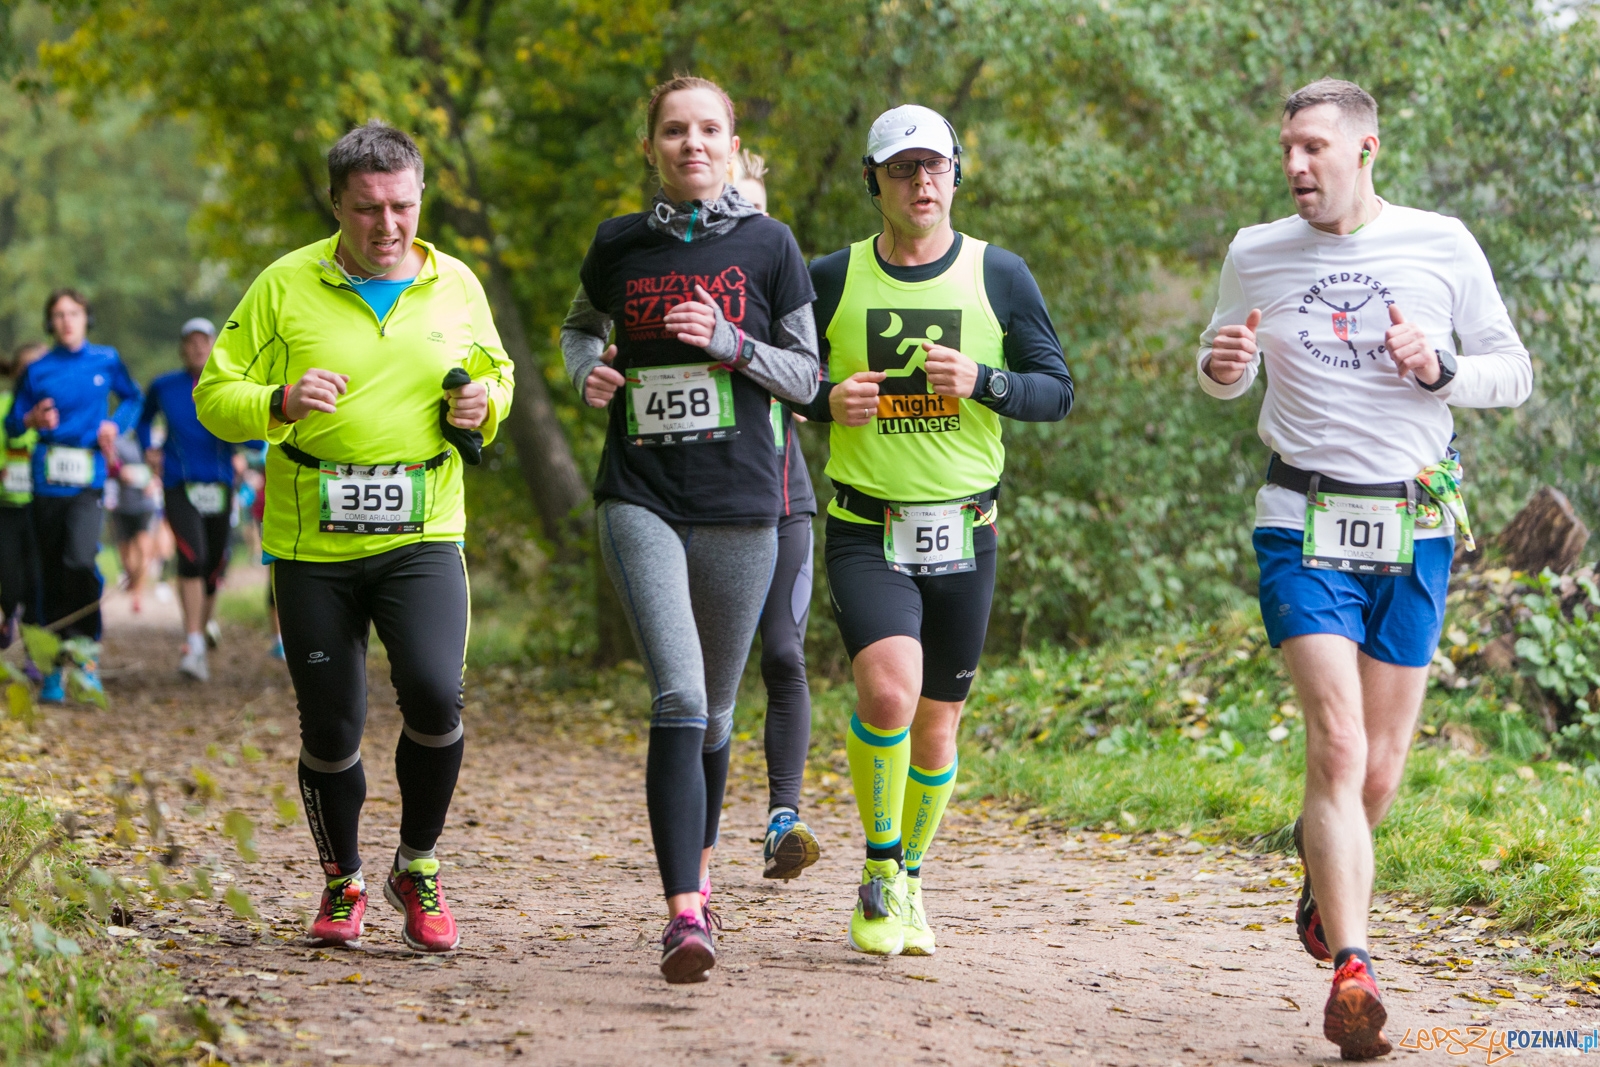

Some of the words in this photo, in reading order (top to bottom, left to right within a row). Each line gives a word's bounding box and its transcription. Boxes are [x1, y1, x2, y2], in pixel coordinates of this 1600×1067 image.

[626, 270, 725, 297] DRUŻYNA
[1298, 330, 1361, 370] Running
[645, 387, 711, 421] 458
[892, 395, 945, 416] night
[662, 422, 696, 431] NATALIA
[878, 416, 960, 434] runners
[341, 484, 404, 512] 359
[344, 512, 368, 521] COMBI
[369, 513, 401, 522] ARIALDO
[915, 525, 949, 553] 56
[1336, 518, 1385, 550] 101
[923, 554, 943, 563] KARLO
[1343, 549, 1375, 559] TOMASZ
